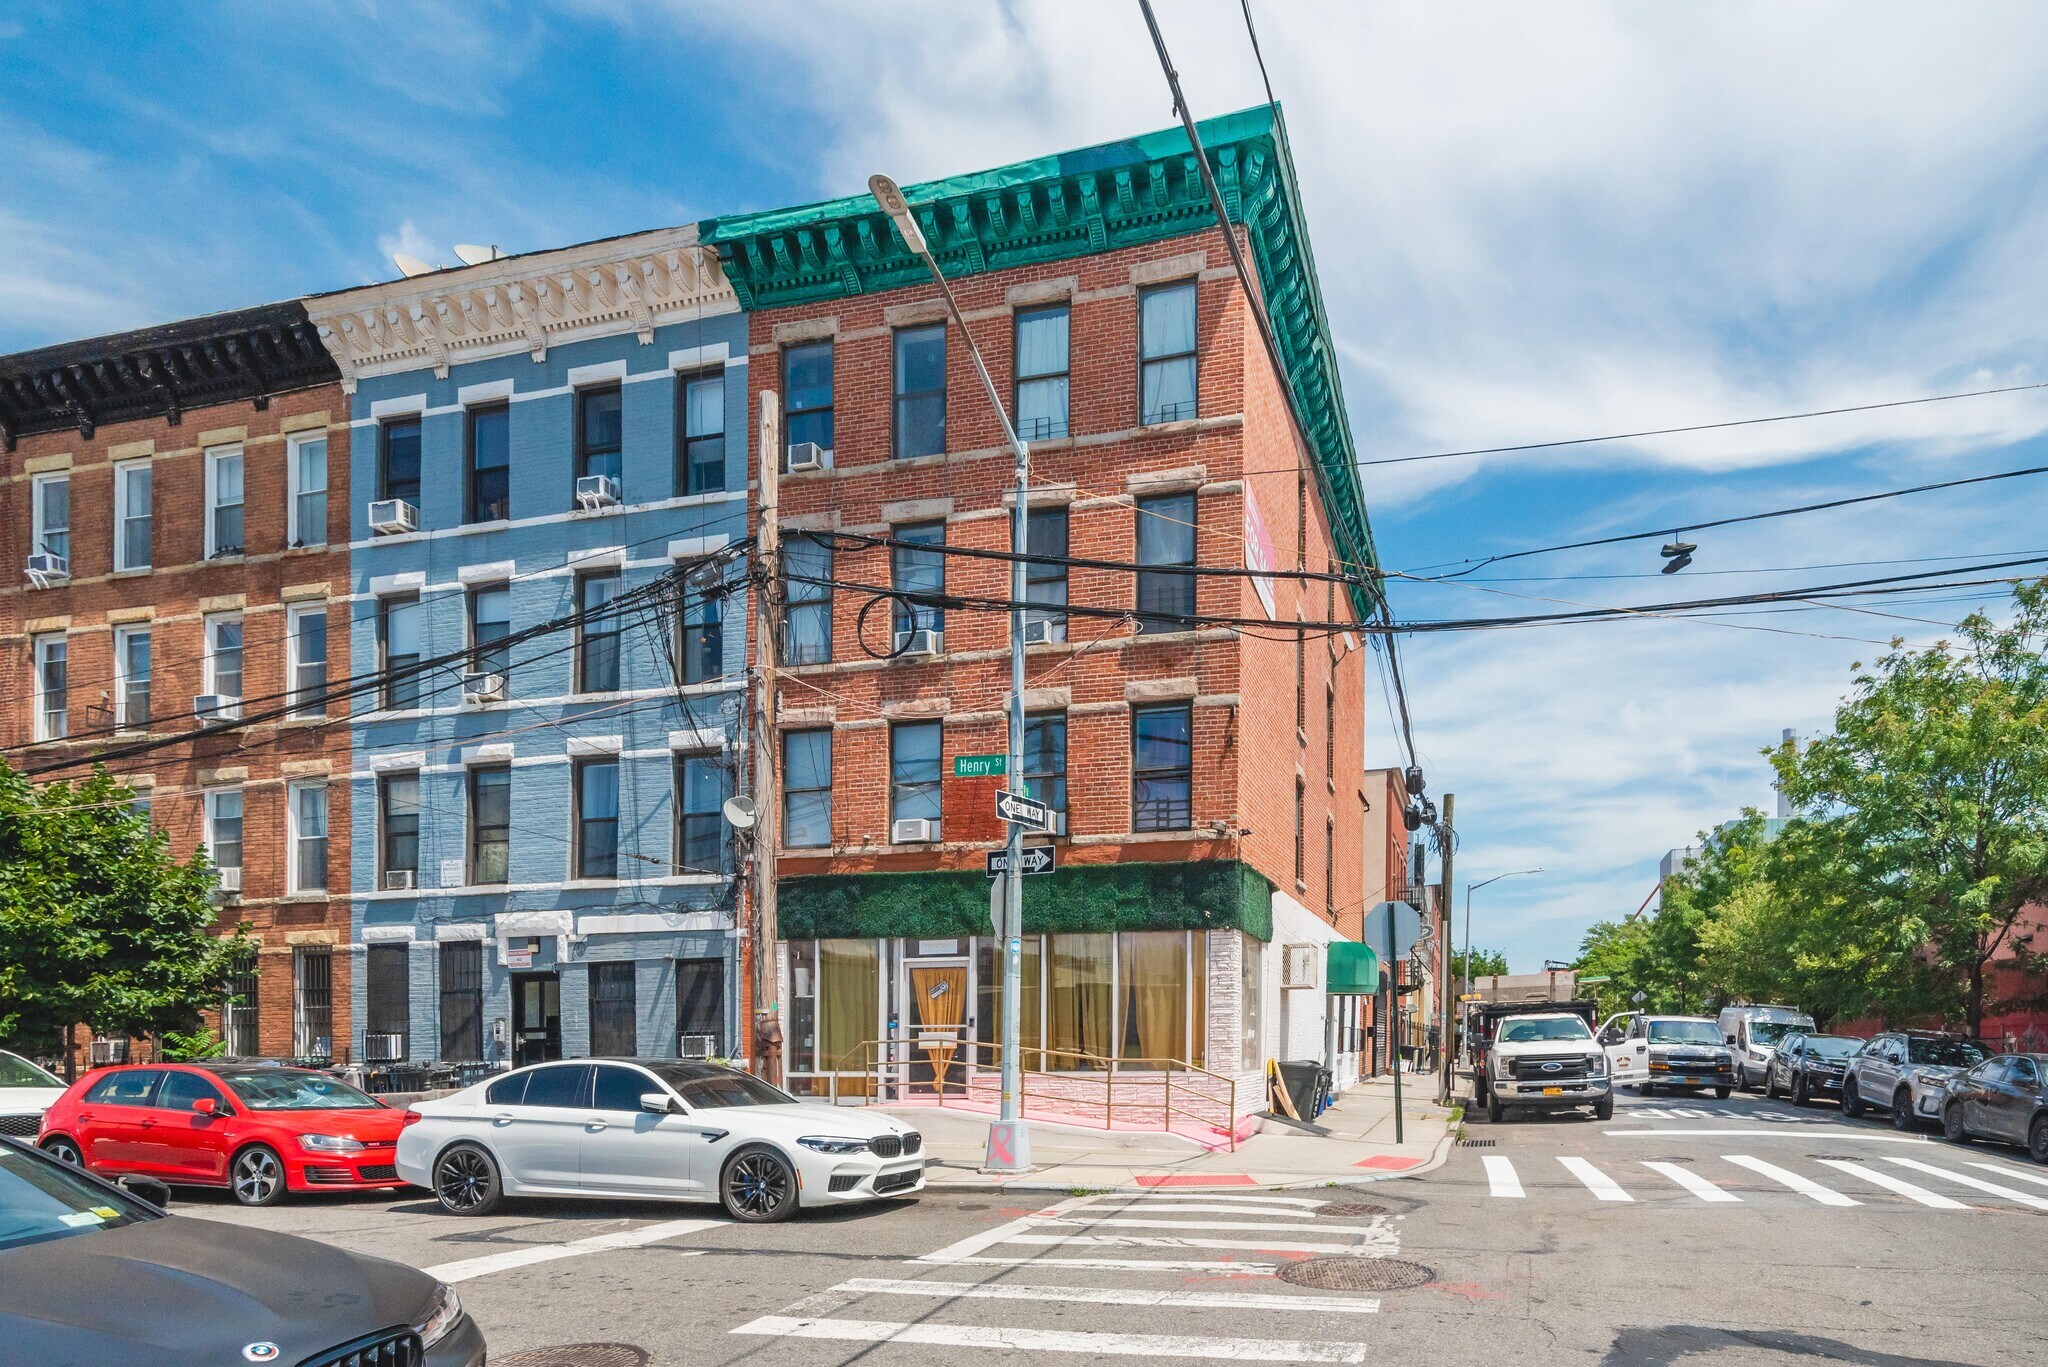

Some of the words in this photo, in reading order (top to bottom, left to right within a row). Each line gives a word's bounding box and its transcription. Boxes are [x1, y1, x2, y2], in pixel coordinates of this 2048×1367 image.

[960, 759, 990, 775] Henry
[995, 758, 1002, 766] St
[1005, 801, 1020, 813] ONE
[1026, 807, 1040, 819] WAY
[996, 857, 1008, 868] ON
[1024, 855, 1044, 866] WAY
